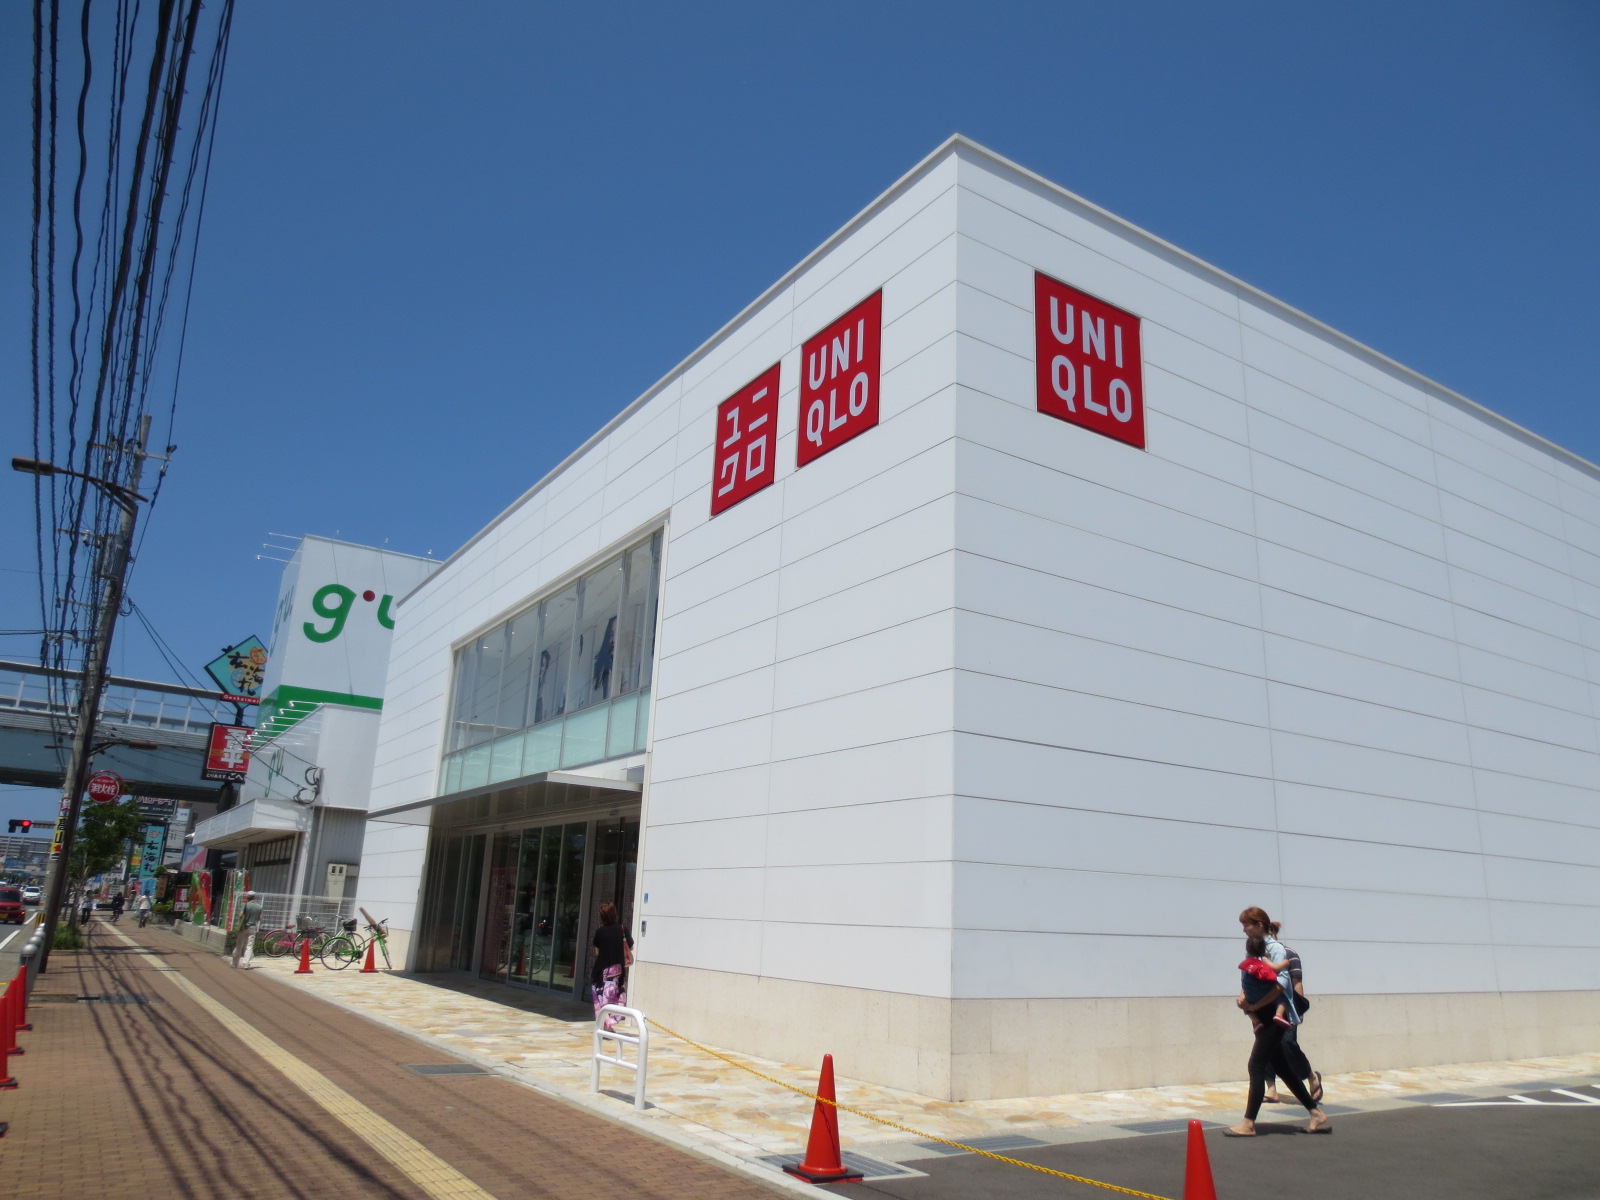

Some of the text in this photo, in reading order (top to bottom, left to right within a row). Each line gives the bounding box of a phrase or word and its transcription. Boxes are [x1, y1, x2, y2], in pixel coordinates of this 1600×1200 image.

[808, 318, 865, 391] UNI
[1050, 295, 1124, 369] UNI
[806, 371, 869, 448] QLO
[1051, 354, 1133, 423] QLO
[91, 782, 117, 795] 消火栓
